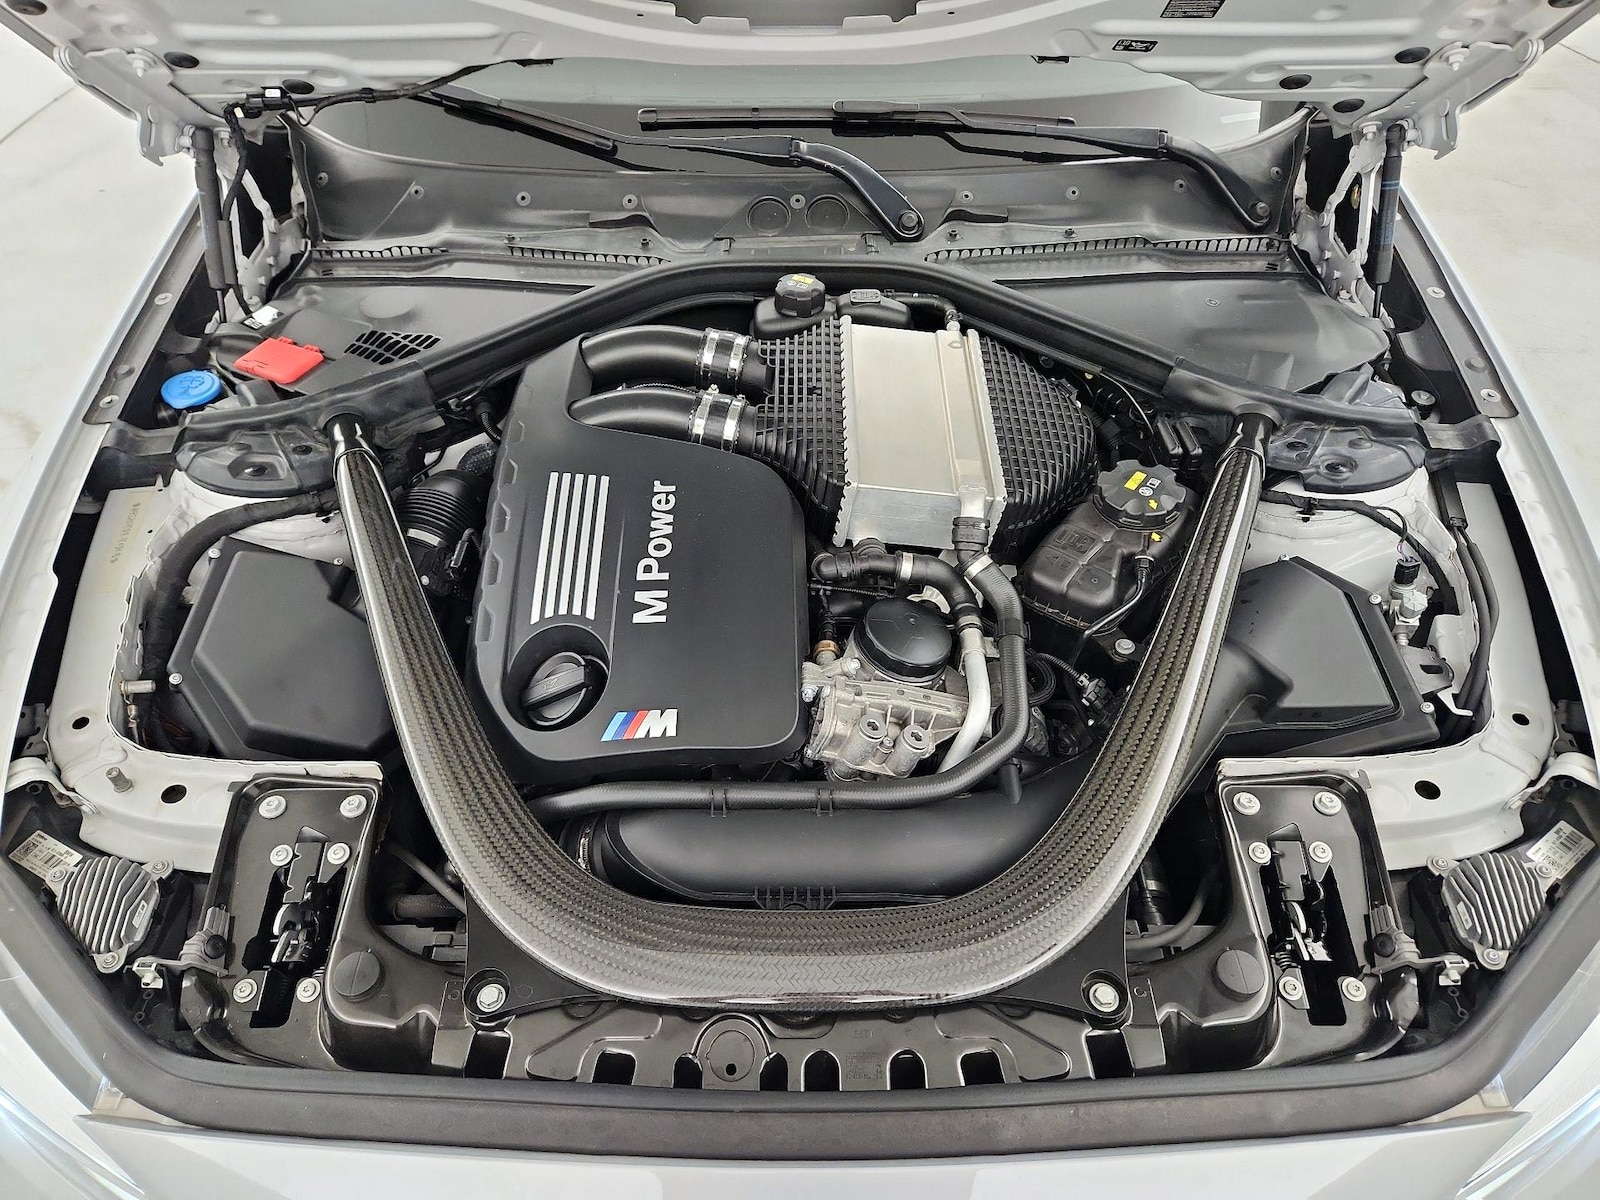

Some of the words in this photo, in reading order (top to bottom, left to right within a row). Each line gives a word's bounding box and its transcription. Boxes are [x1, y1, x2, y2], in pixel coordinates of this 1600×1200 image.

[636, 480, 677, 581] Power
[632, 590, 668, 624] M
[633, 709, 677, 739] M
